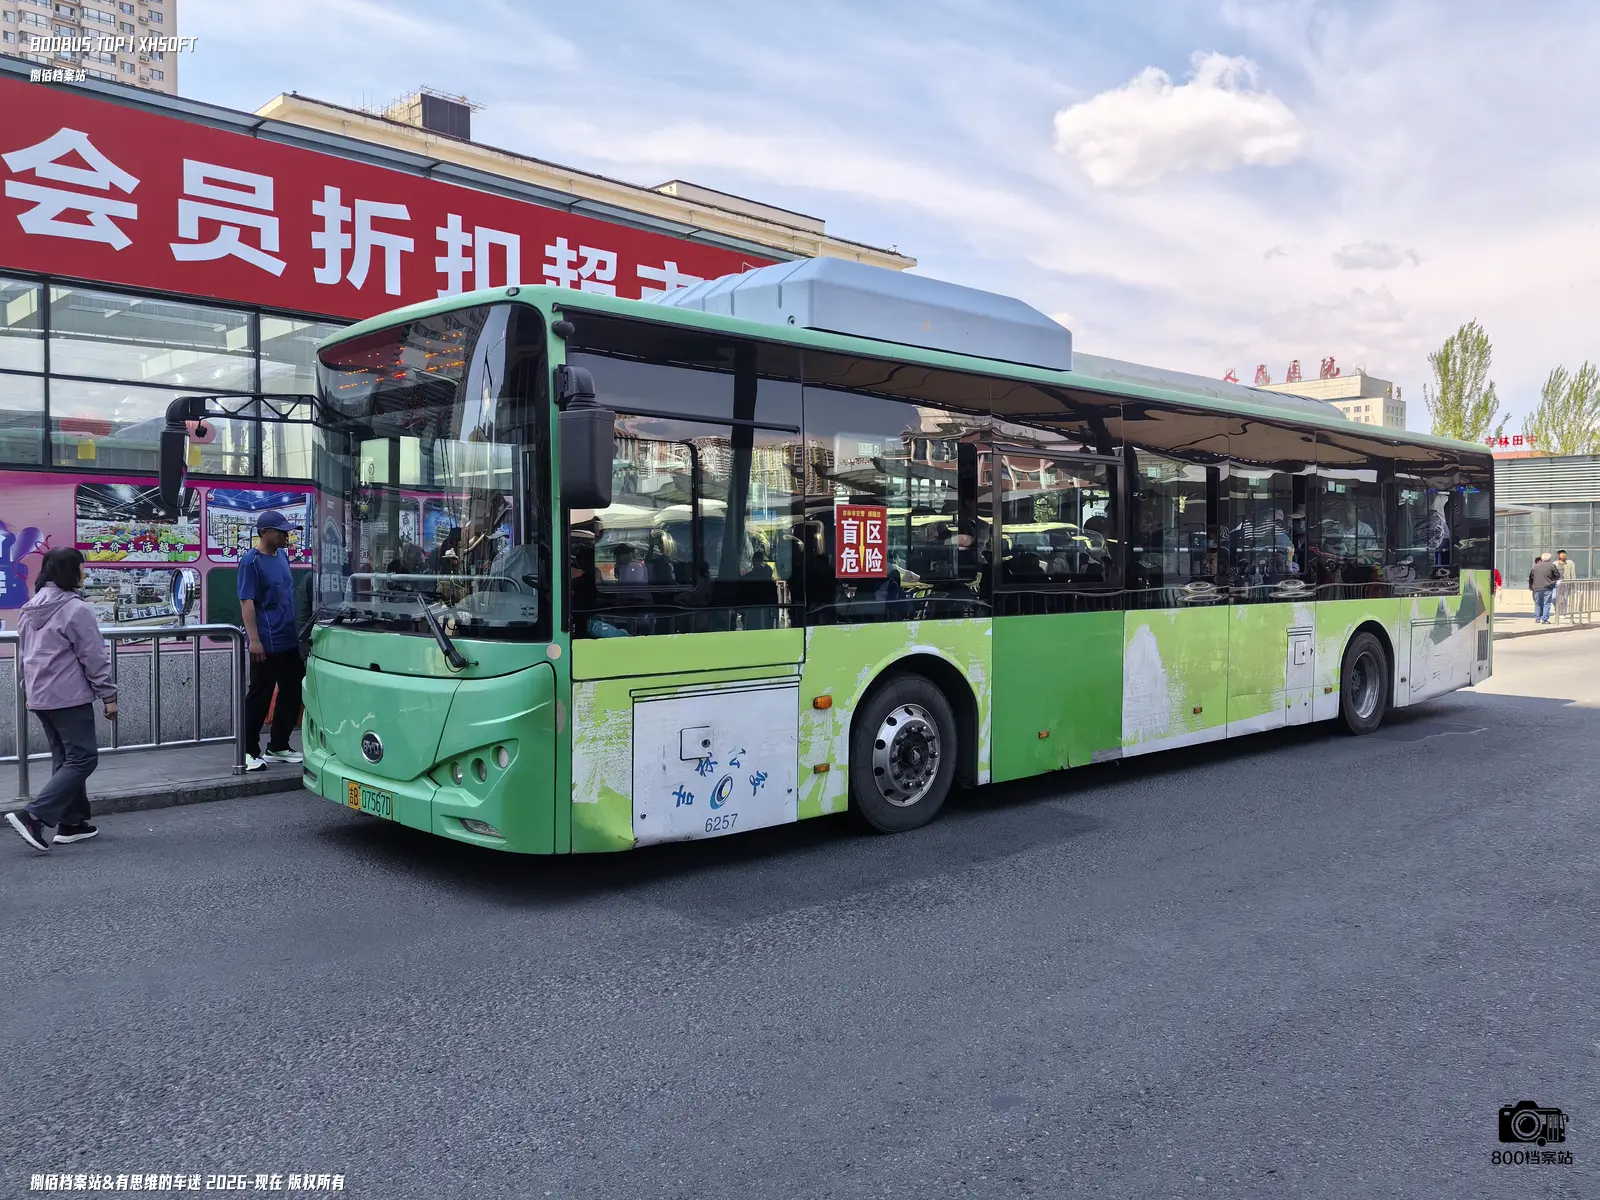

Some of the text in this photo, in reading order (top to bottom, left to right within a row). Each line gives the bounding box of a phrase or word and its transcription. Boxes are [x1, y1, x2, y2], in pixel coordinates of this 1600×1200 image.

[841, 518, 883, 545] 盲区
[93, 541, 186, 555] 平价生活超市
[841, 547, 883, 573] 危险
[705, 813, 738, 833] 6257
